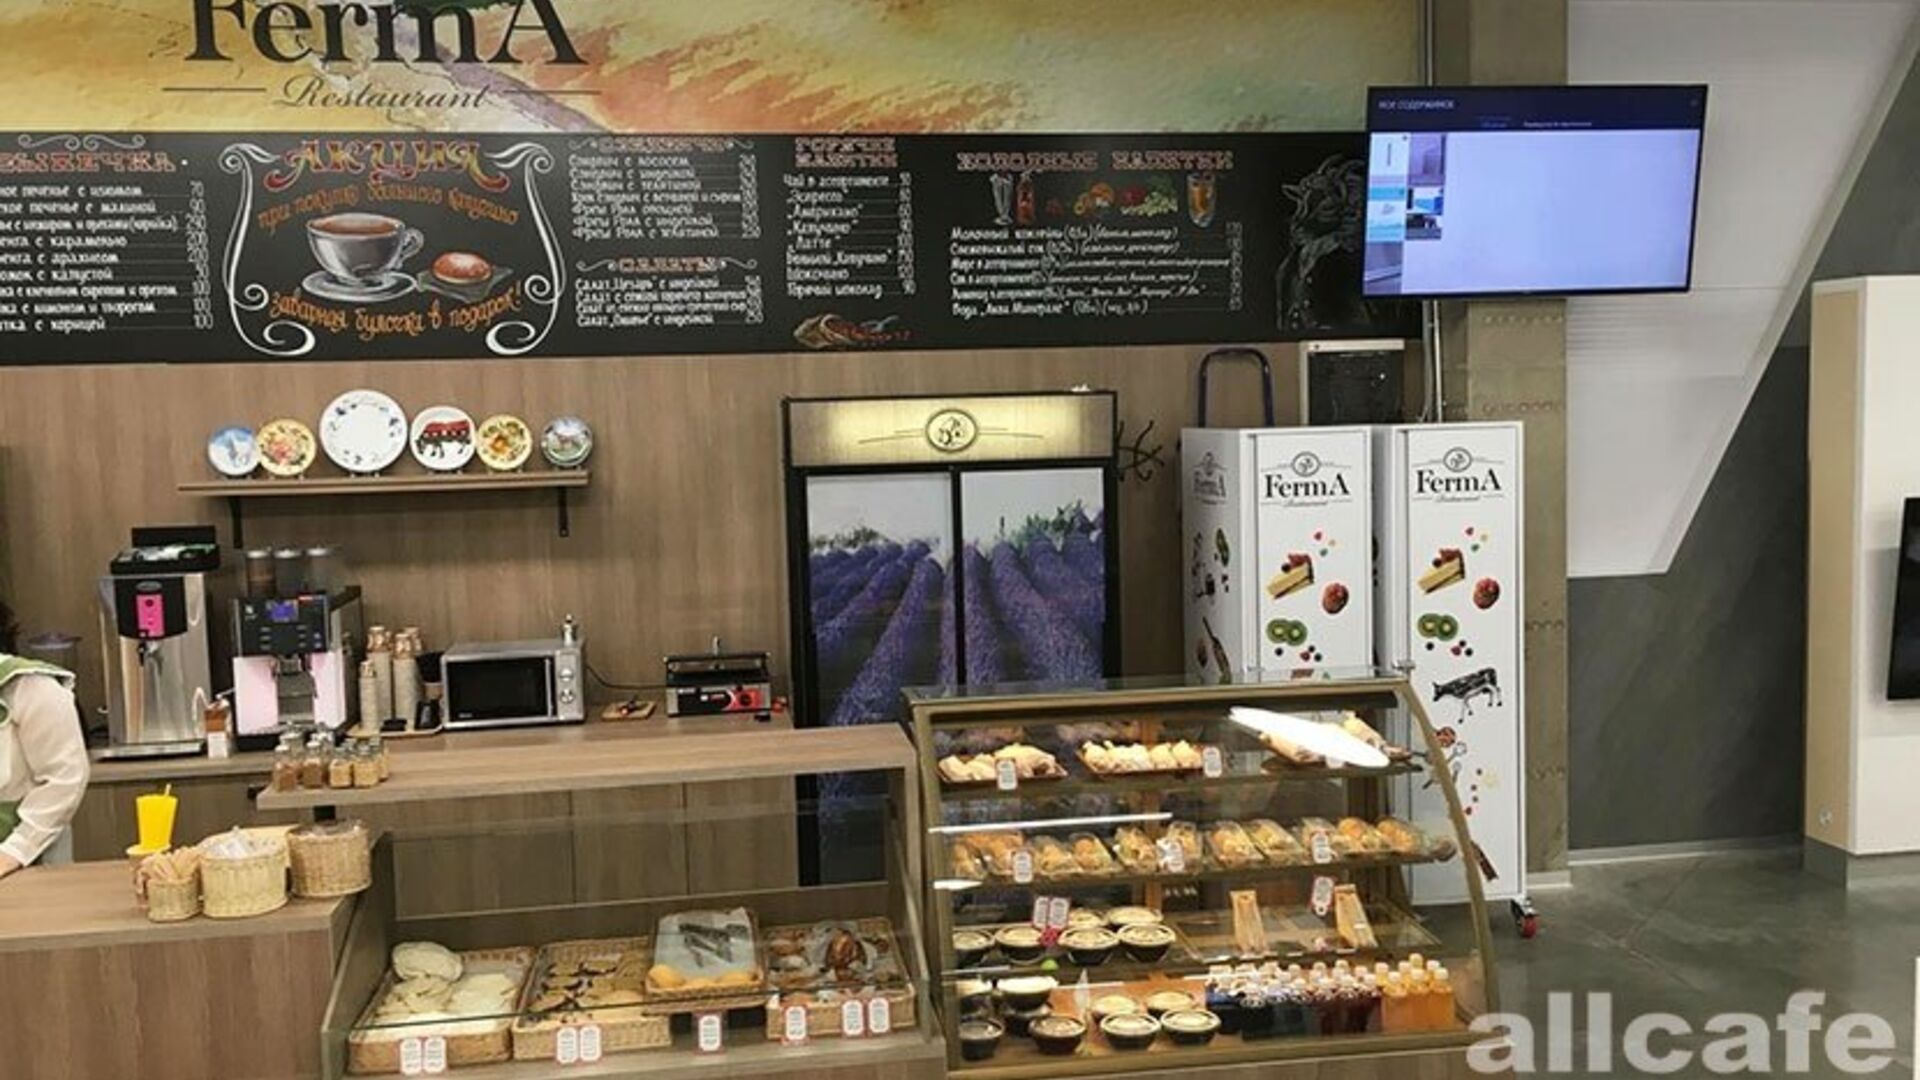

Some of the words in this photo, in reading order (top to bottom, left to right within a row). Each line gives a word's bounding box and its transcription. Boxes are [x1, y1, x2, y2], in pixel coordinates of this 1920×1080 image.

[185, 0, 589, 64] FermA
[280, 75, 497, 109] Restaurant
[264, 140, 510, 192] АКЦИЯ
[1264, 473, 1350, 499] FermA
[1416, 468, 1502, 494] FermA
